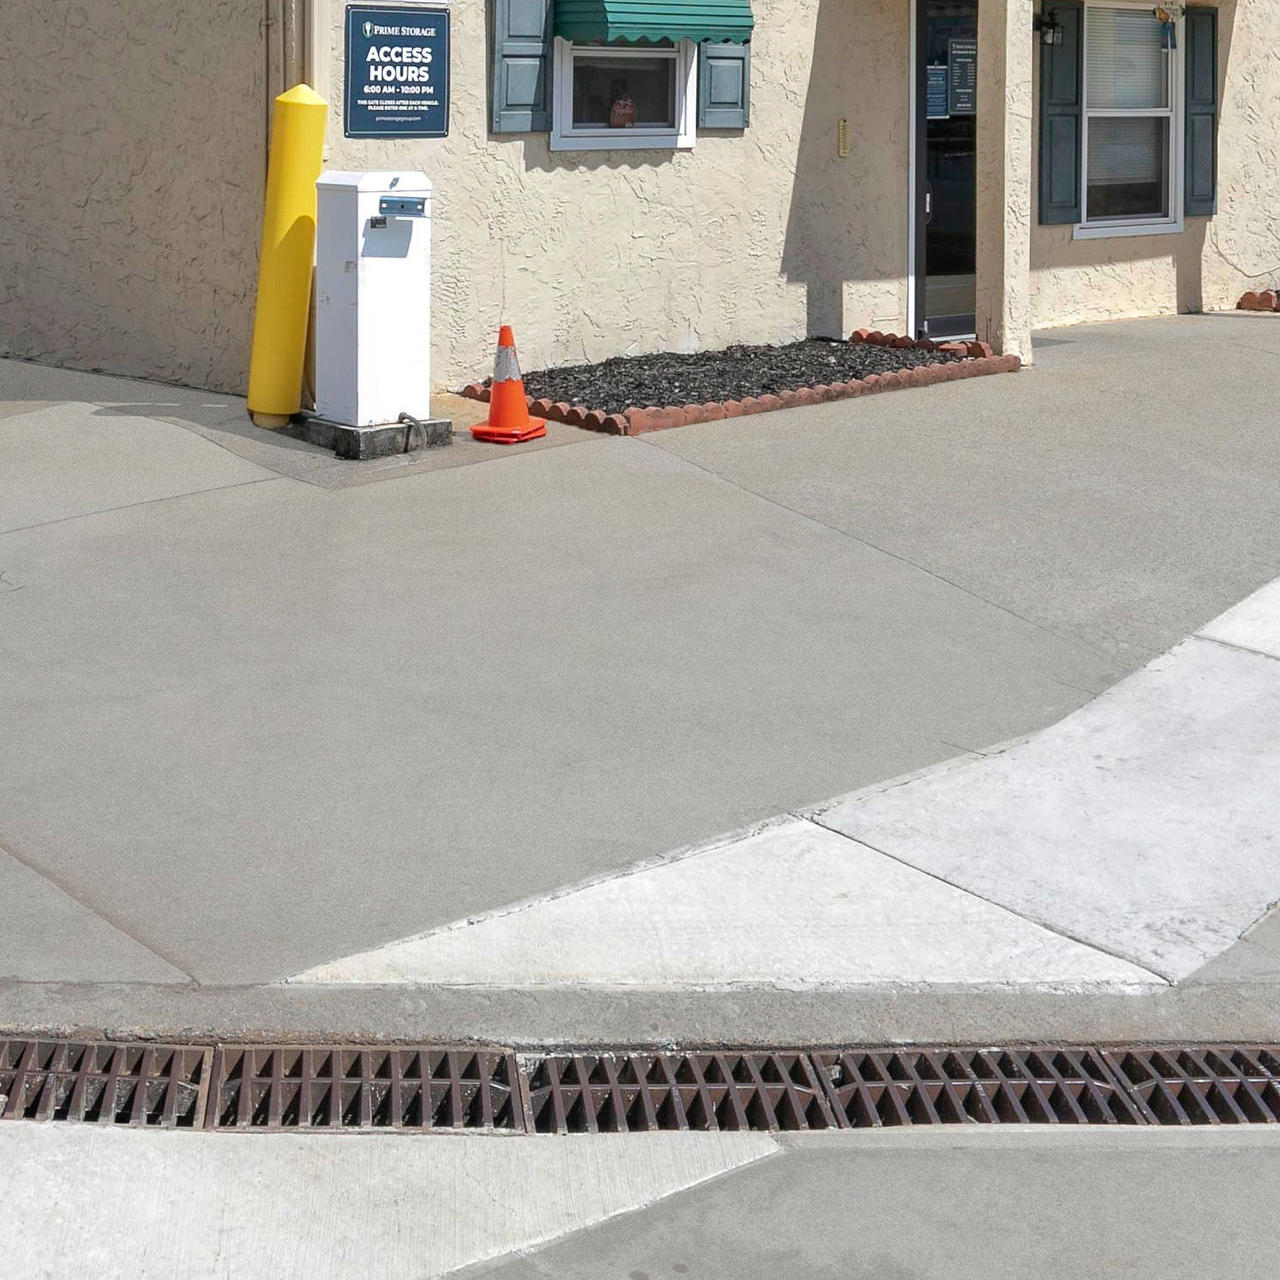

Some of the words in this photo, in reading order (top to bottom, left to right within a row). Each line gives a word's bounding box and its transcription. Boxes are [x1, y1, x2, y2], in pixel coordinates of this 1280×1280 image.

[374, 25, 400, 36] PRIME
[401, 26, 436, 36] STORAGE
[366, 45, 433, 63] ACCESS
[369, 65, 430, 82] HOURS
[363, 85, 381, 94] 6:00
[382, 85, 396, 94] AM
[401, 85, 421, 94] 10:00
[421, 86, 434, 94] PM
